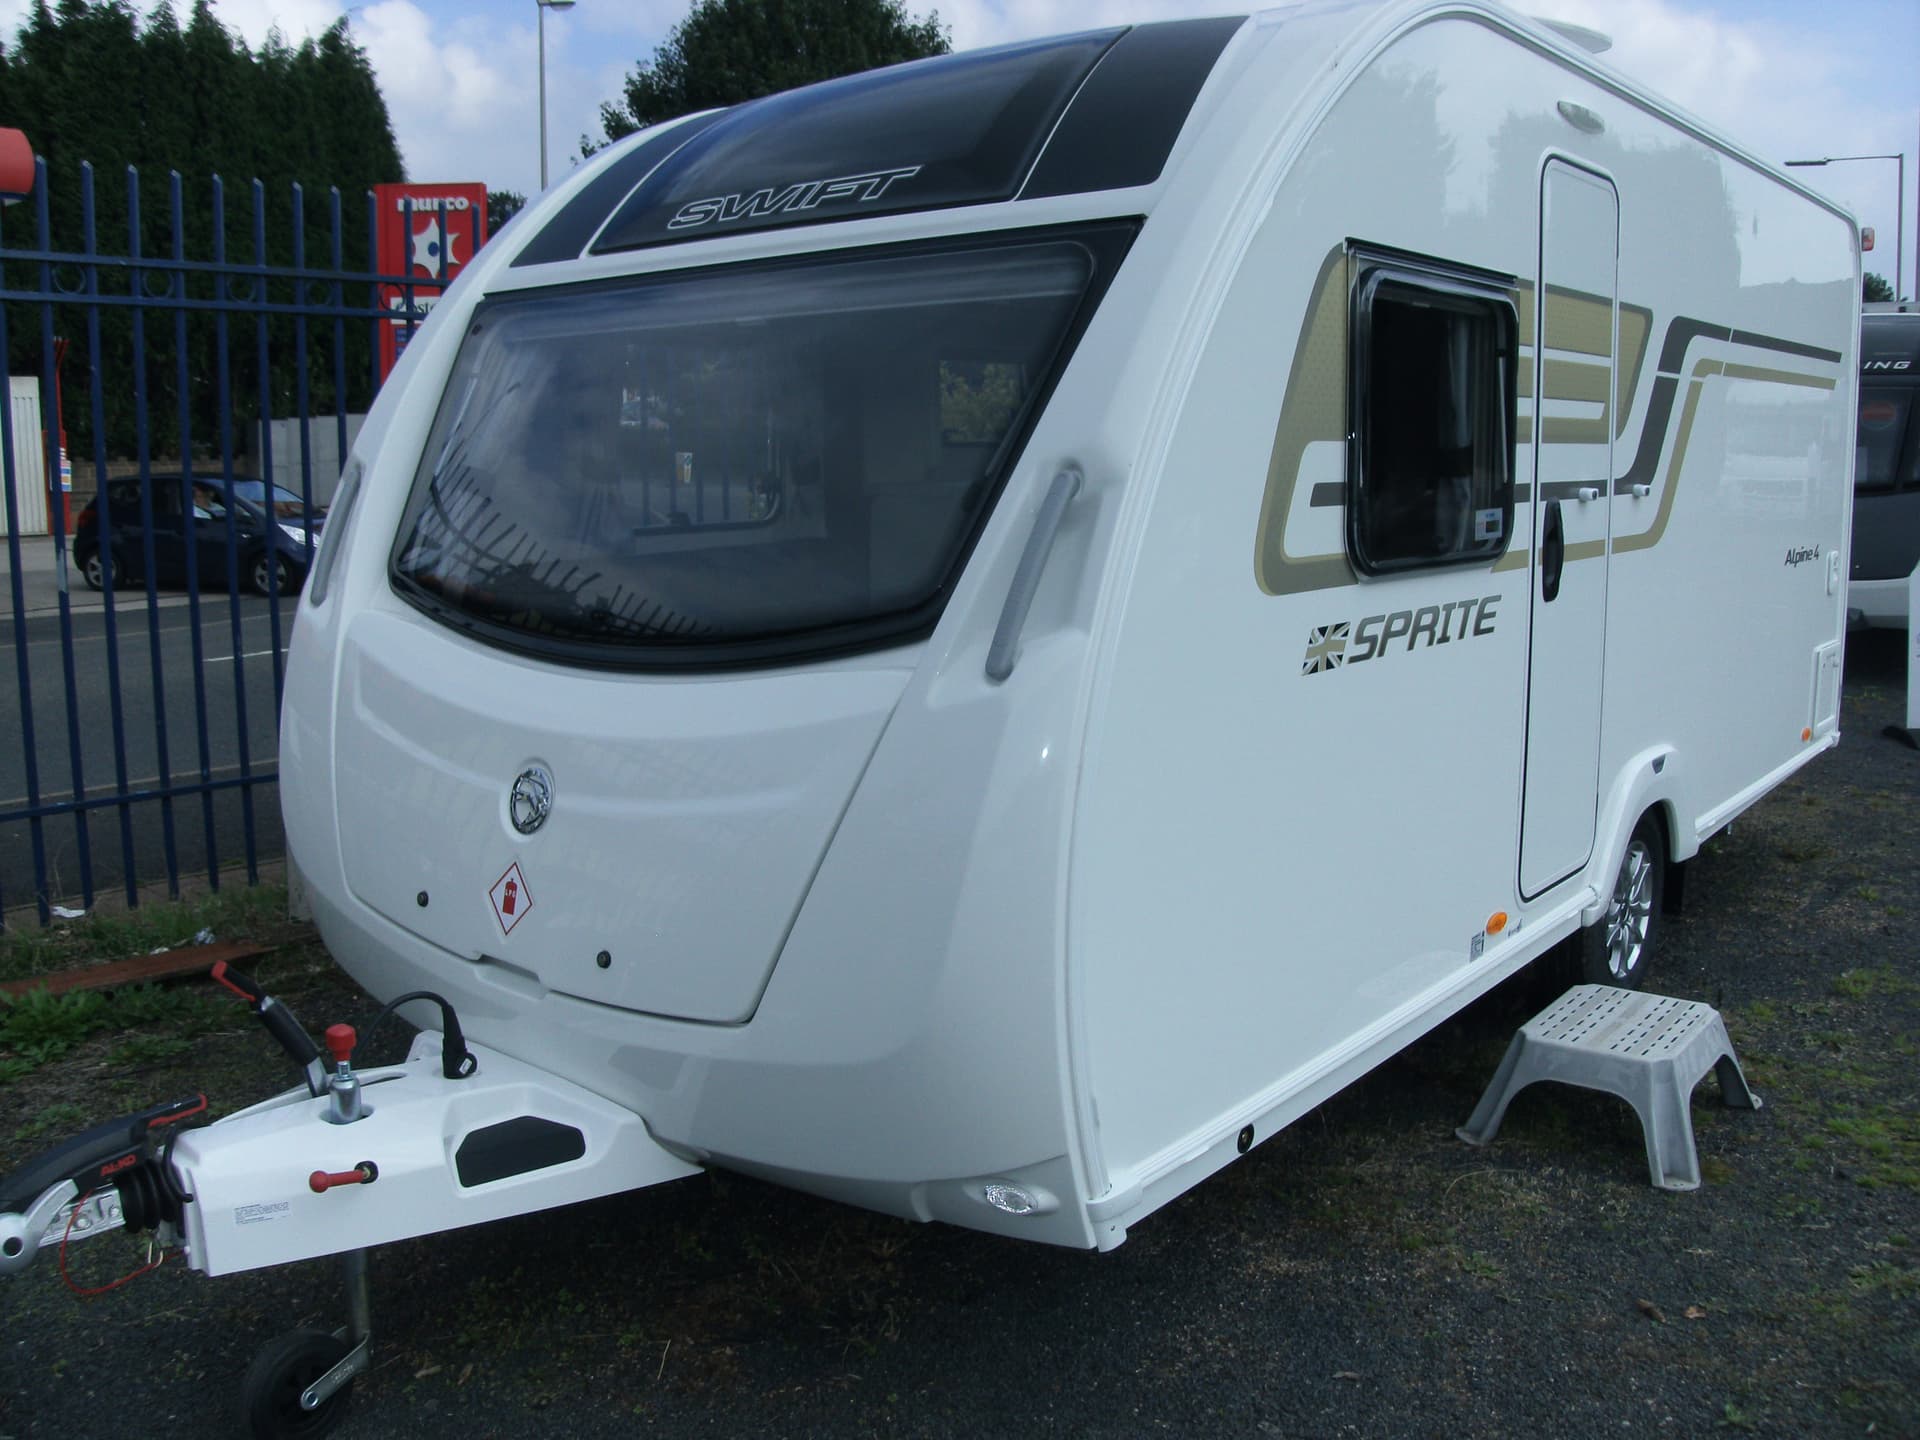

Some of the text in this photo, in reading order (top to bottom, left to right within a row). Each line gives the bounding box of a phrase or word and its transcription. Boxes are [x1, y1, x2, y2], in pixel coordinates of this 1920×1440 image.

[397, 196, 469, 212] murco
[667, 165, 923, 229] SWIFT
[1347, 595, 1502, 665] SPRITE
